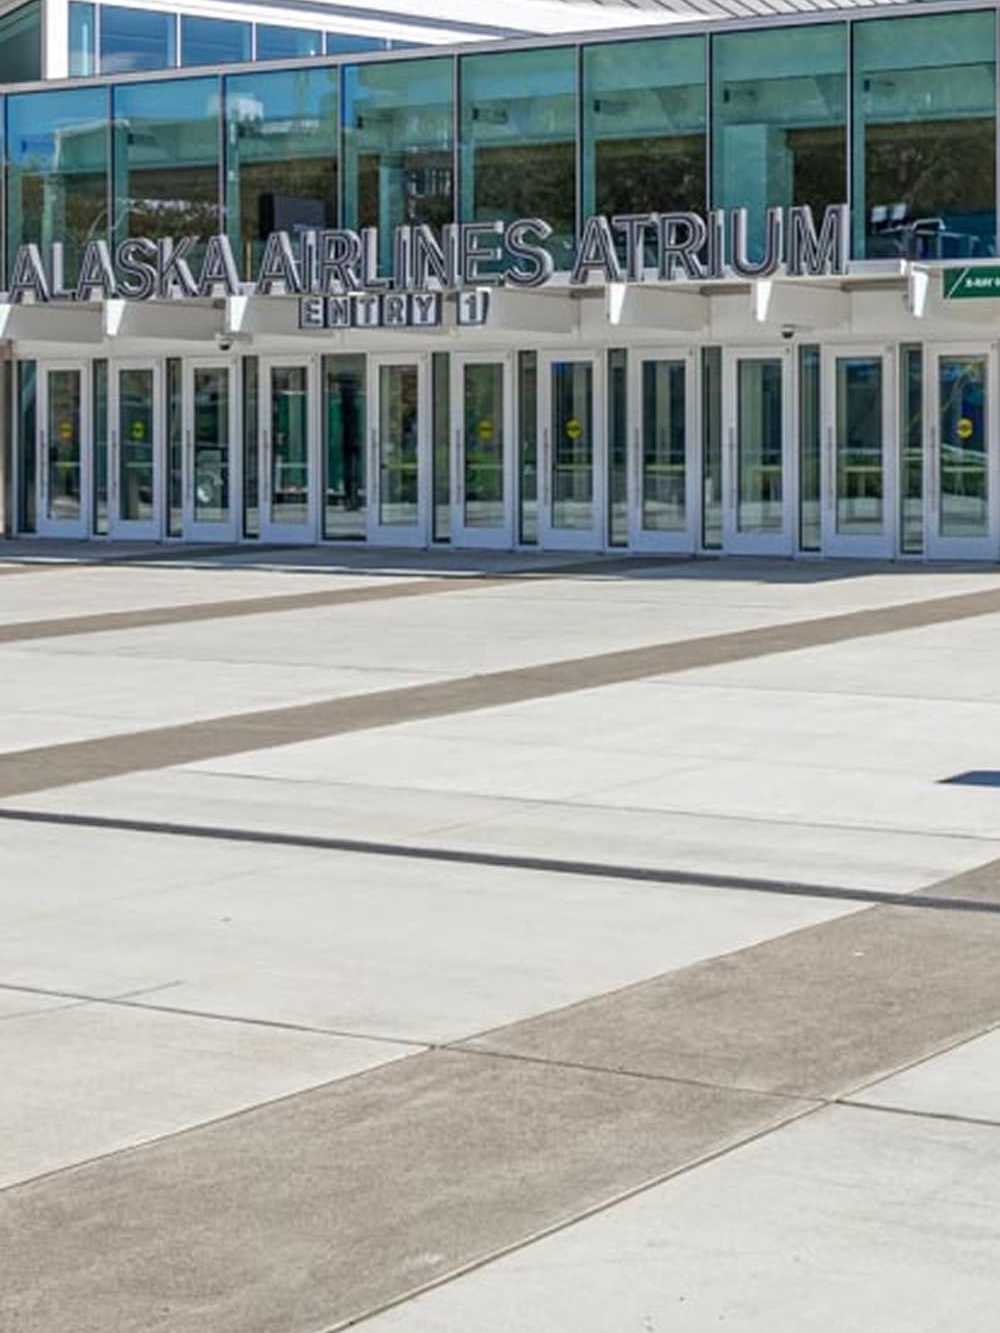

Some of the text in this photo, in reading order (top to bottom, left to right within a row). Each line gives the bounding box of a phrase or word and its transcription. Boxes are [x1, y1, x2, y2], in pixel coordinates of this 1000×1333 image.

[8, 203, 850, 305] ALASKA AIRLINES ATRIUM
[301, 294, 438, 327] ENTRY
